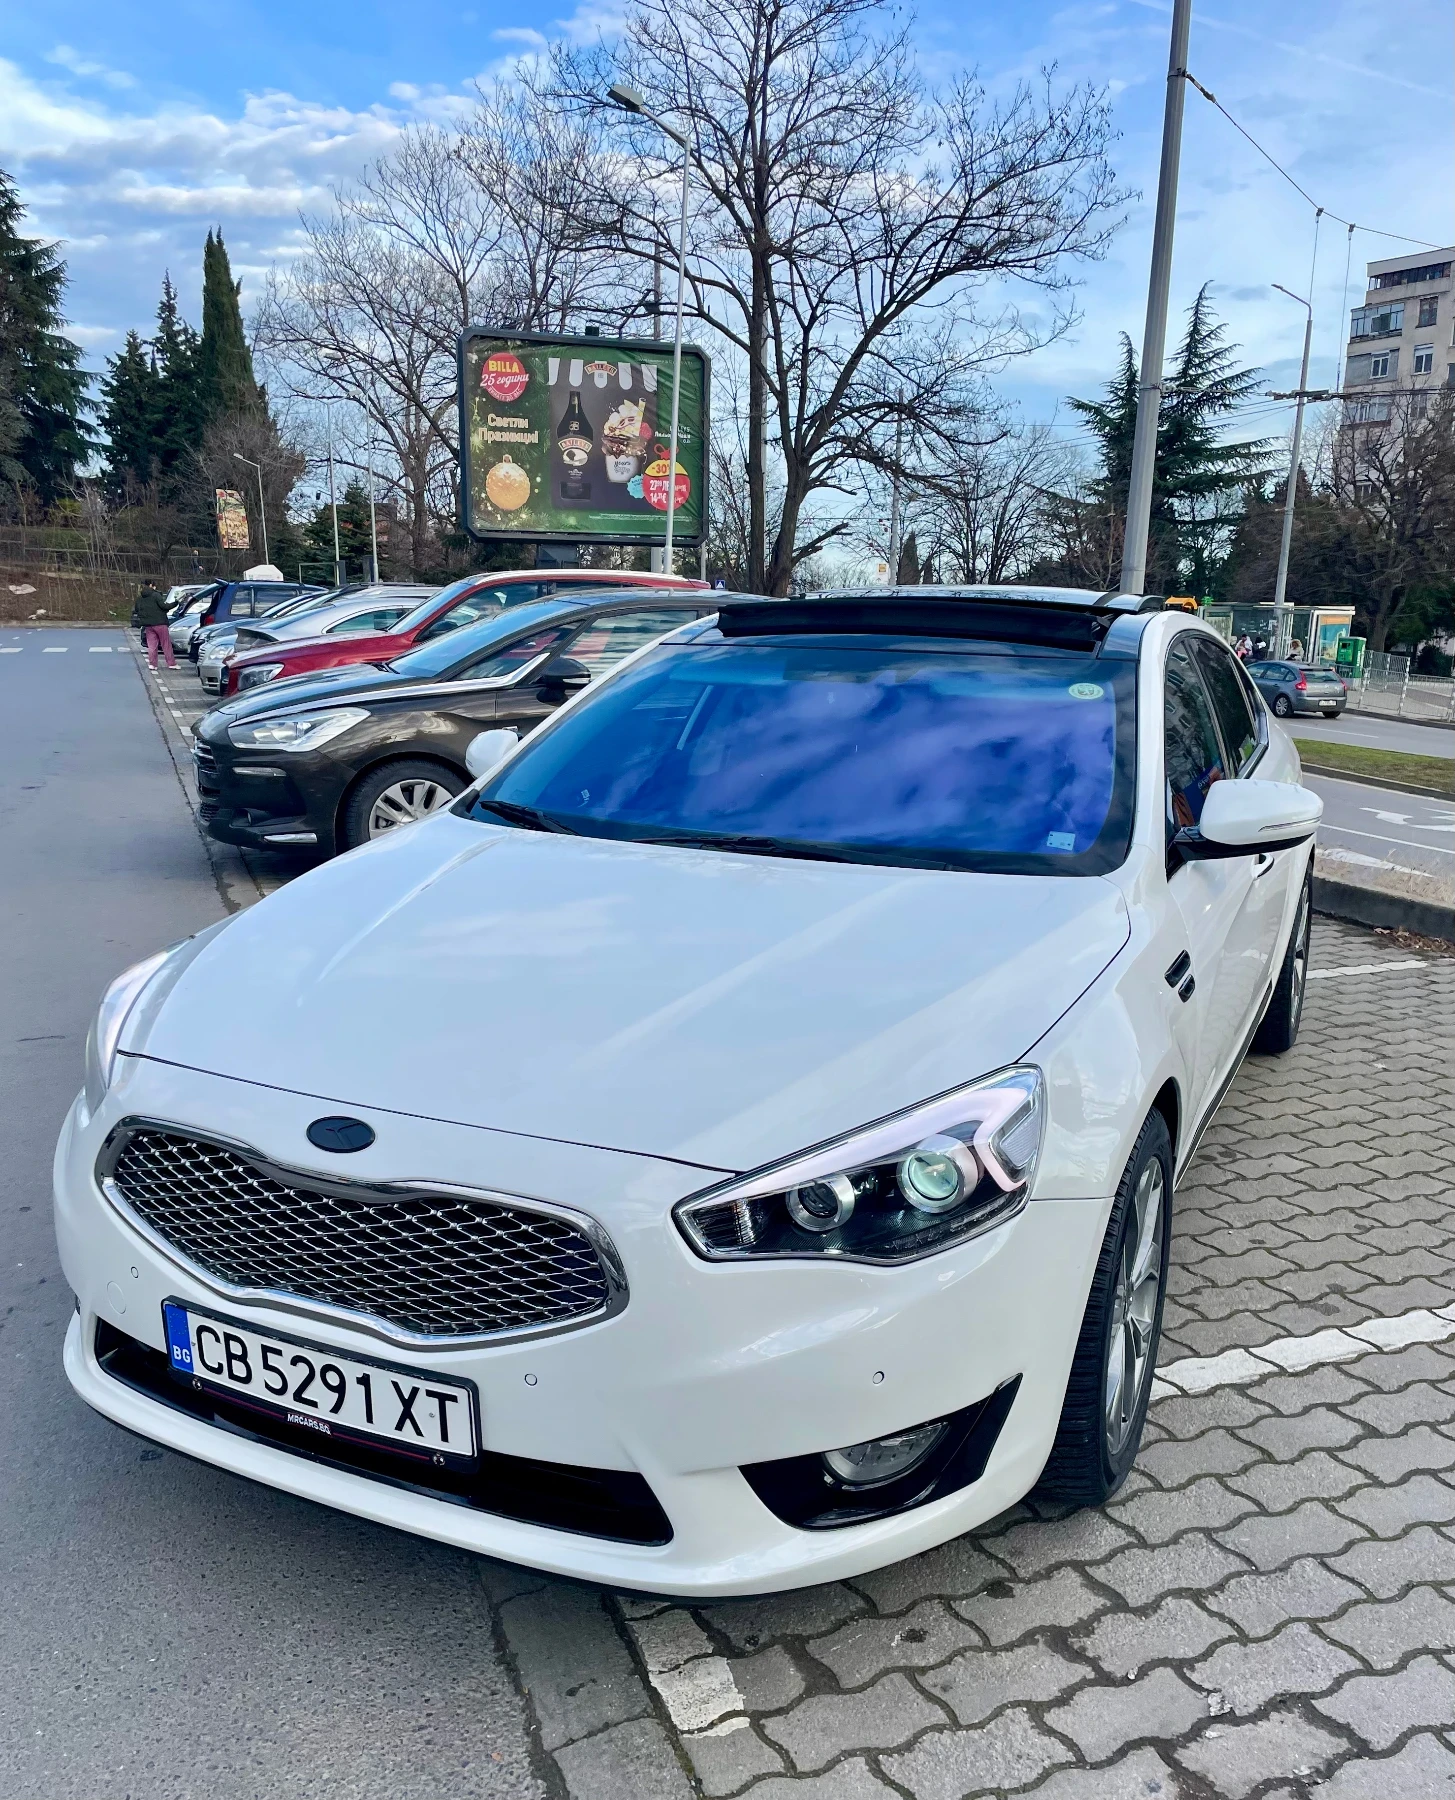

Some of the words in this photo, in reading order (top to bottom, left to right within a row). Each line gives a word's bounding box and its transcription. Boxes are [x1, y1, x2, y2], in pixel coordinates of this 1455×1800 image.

[488, 360, 520, 373] BILLA
[480, 373, 496, 387] 25
[496, 373, 530, 388] години
[487, 413, 529, 428] Светли
[478, 427, 539, 444] Празници!
[651, 463, 670, 474] -30
[172, 1344, 191, 1363] BG
[195, 1324, 253, 1385] CB
[260, 1343, 374, 1425] 5291
[390, 1379, 459, 1443] XT
[287, 1413, 332, 1436] MRCARS.BG
